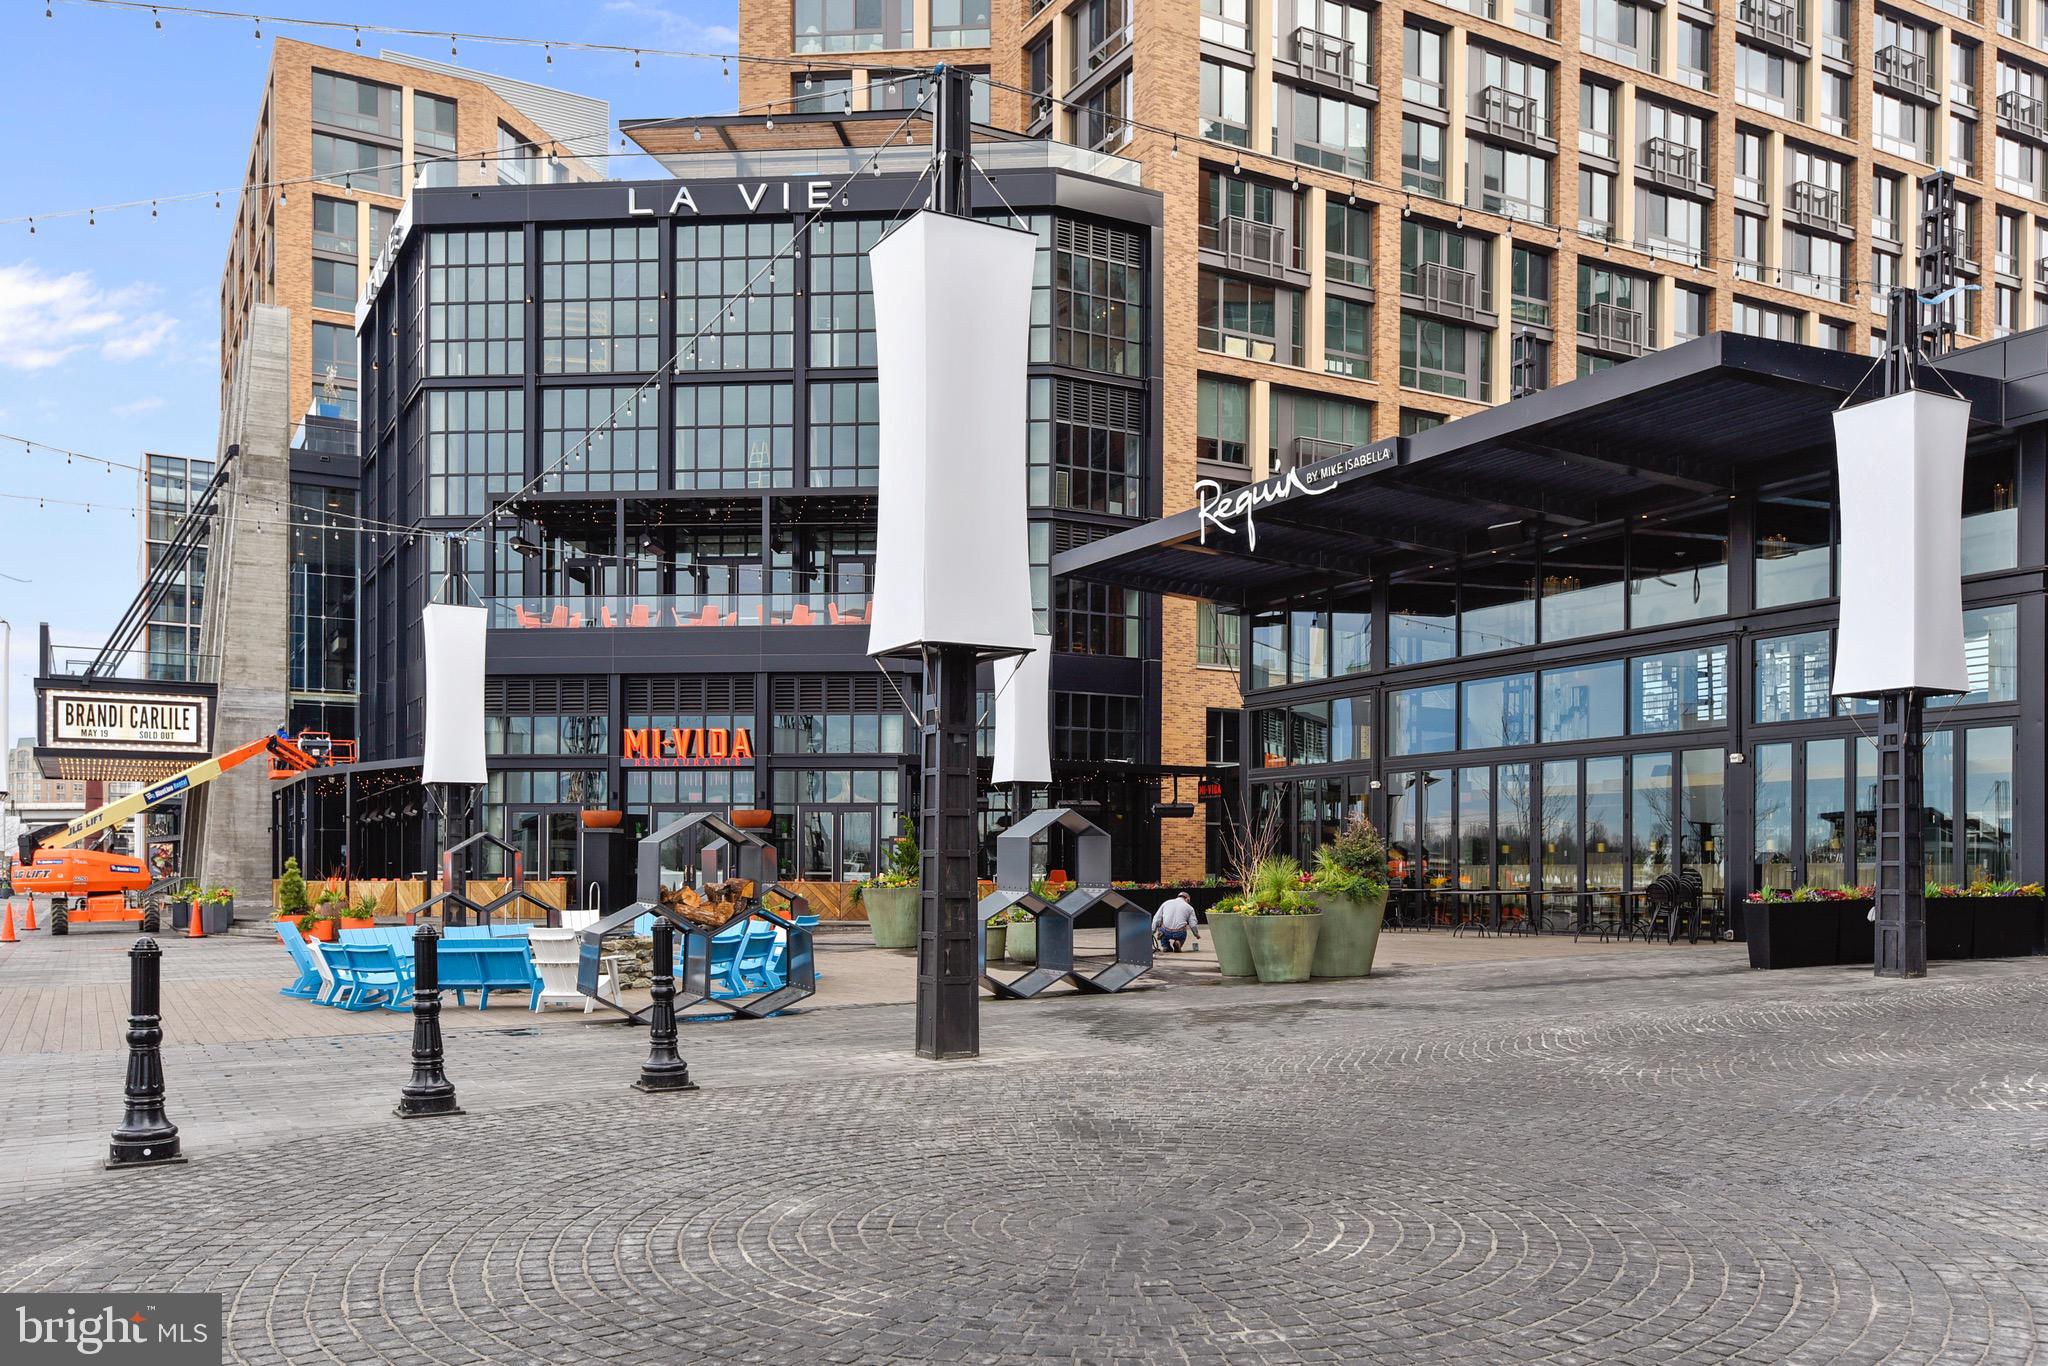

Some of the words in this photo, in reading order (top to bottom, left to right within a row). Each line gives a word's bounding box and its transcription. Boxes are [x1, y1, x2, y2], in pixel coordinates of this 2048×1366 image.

[628, 186, 699, 216] LA
[737, 181, 832, 212] VIE
[1306, 470, 1318, 484] BY
[1320, 462, 1343, 479] MIKE
[1345, 448, 1390, 471] ISABELLA
[1194, 459, 1338, 552] Requin
[65, 703, 123, 728] BRANDI
[130, 706, 190, 730] CARLILE
[81, 729, 97, 737] MAY
[140, 731, 158, 739] SOLD
[623, 728, 661, 759] MI
[672, 728, 753, 759] VIDA
[633, 758, 741, 766] RESTAURANTE
[68, 823, 83, 836] JLG
[86, 813, 103, 828] LIFT
